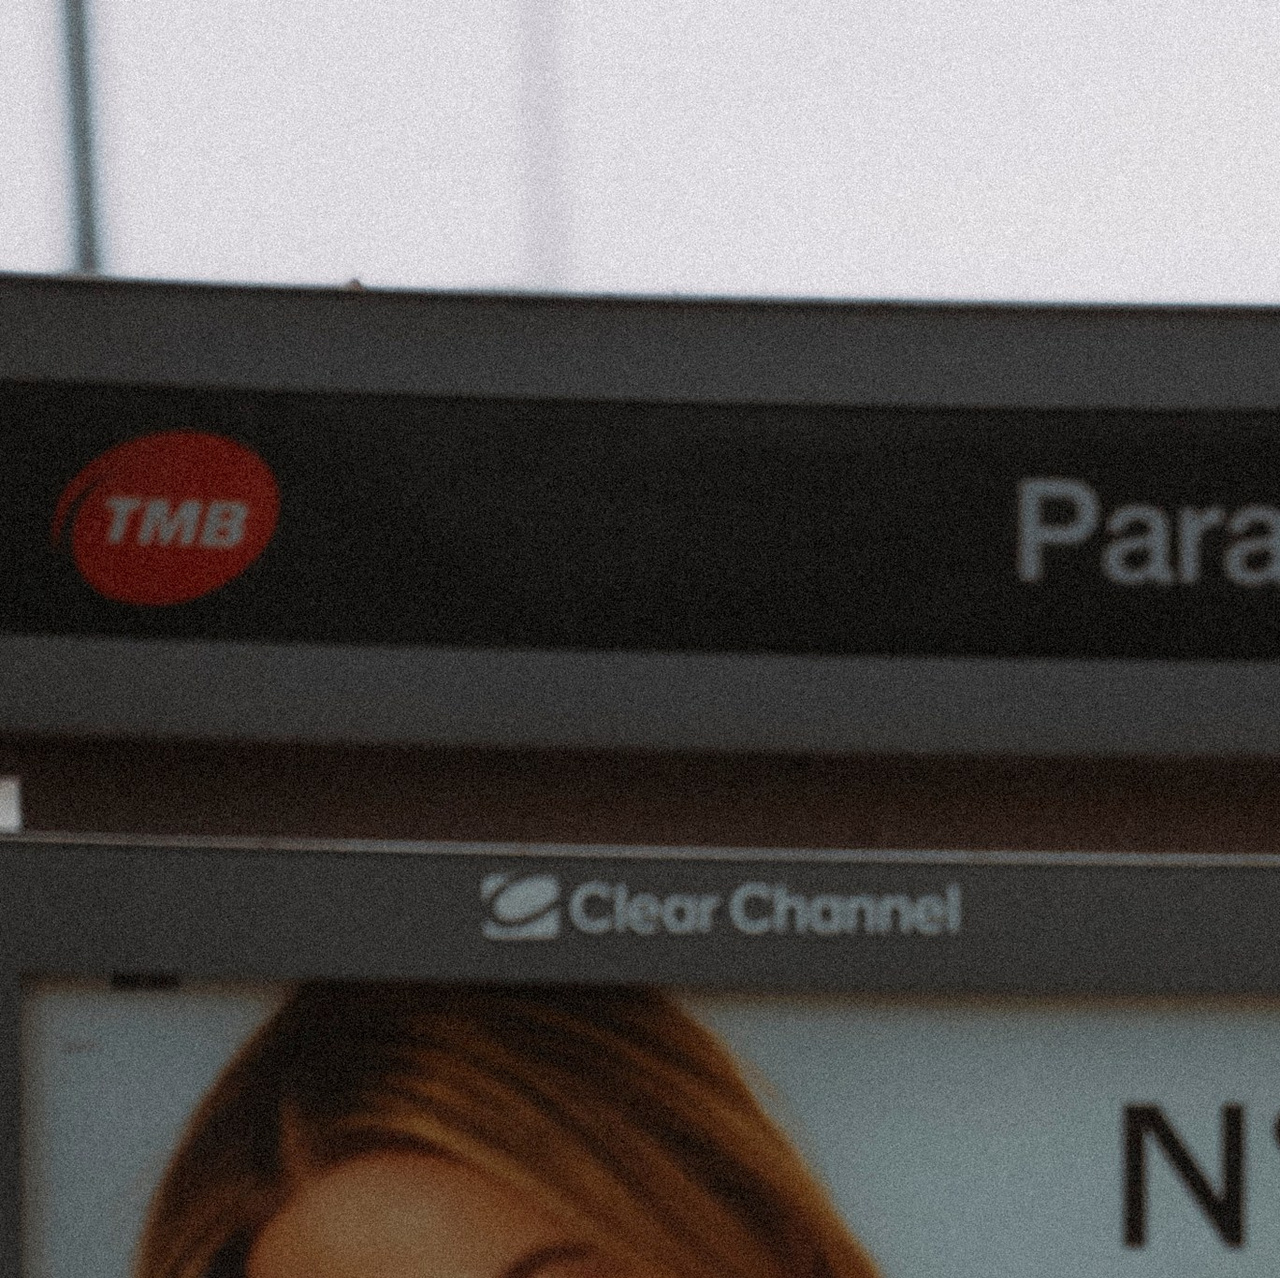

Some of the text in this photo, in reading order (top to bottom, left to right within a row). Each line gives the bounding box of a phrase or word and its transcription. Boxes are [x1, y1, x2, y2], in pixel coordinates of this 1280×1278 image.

[105, 496, 249, 549] TMB
[568, 879, 962, 937] Clear Channel
